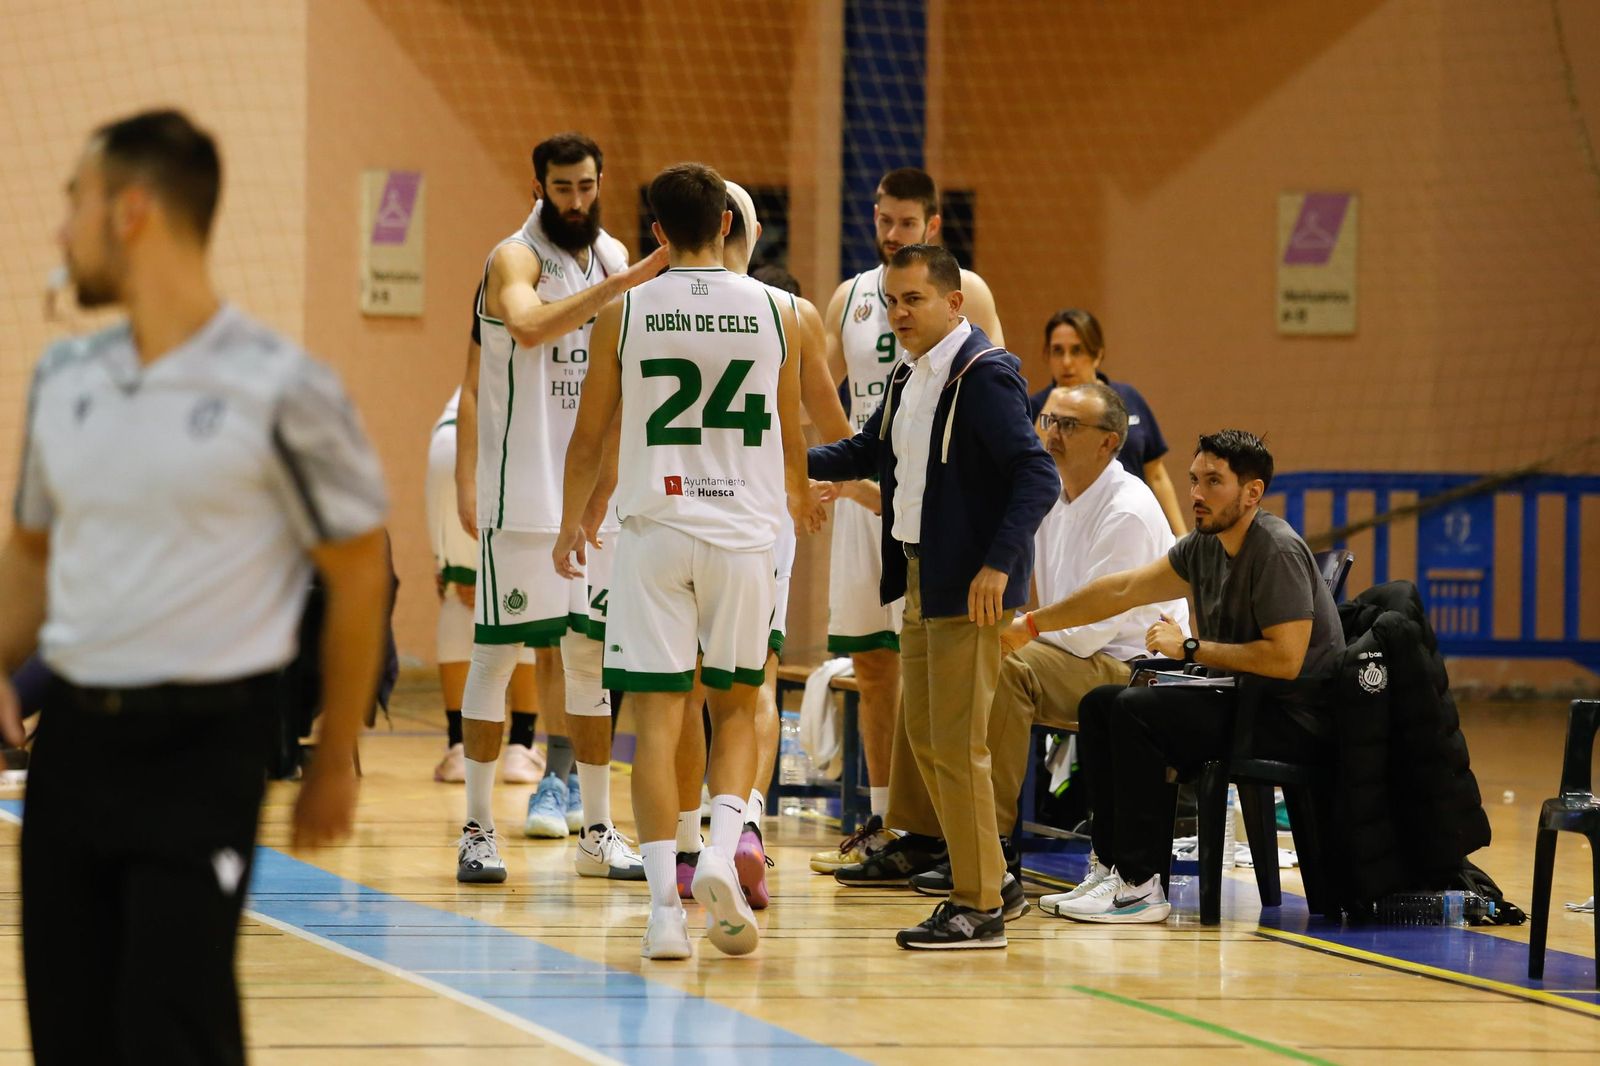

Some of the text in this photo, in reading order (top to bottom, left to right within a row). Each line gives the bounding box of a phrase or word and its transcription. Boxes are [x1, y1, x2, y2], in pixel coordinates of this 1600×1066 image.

[645, 309, 759, 334] RUBÍN DE CELIS
[876, 331, 897, 363] 9
[639, 358, 772, 447] 24
[684, 488, 735, 498] de Huesca
